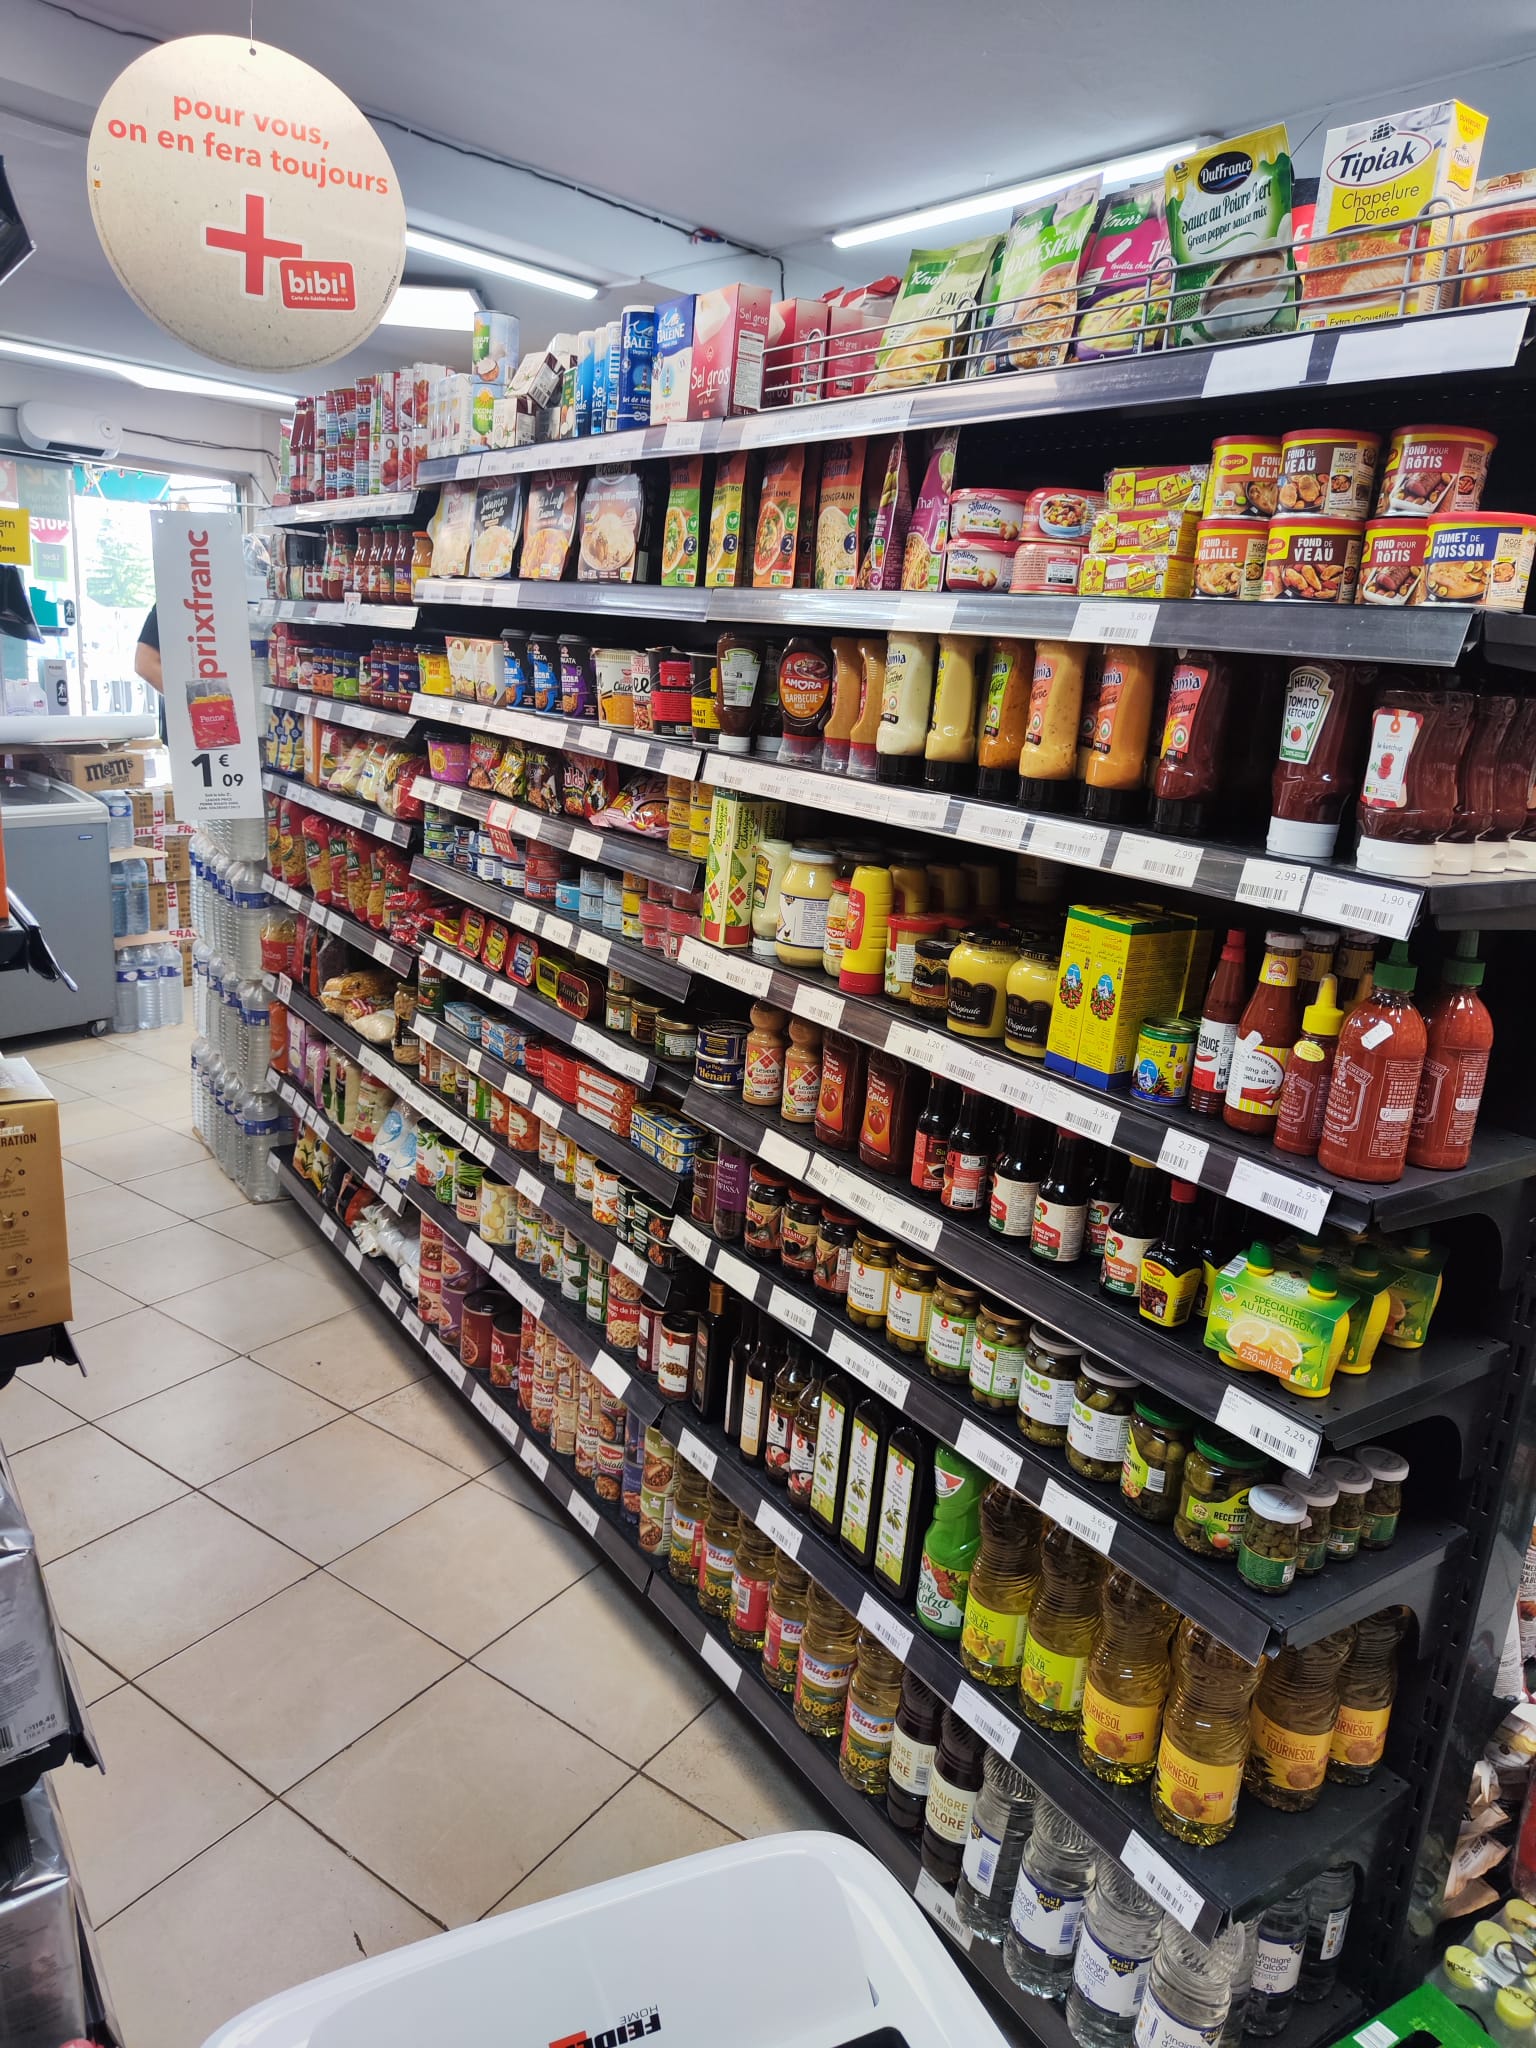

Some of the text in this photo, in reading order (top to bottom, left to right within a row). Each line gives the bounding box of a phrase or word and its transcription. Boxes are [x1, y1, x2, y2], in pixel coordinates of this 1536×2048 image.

[174, 95, 330, 150] pour vous,
[108, 119, 388, 195] on en fera toujours
[1339, 141, 1418, 182] Tipiak
[1342, 184, 1420, 211] Chapelure
[1209, 207, 1221, 223] au
[1223, 194, 1250, 219] Poivre
[1355, 204, 1400, 223] Dorée
[1187, 206, 1267, 251] Green pepper sauce mix
[739, 308, 768, 327] Sel gros
[657, 323, 685, 344] BALEINE
[691, 366, 729, 397] Sel gros
[1287, 448, 1305, 459] FOND
[1404, 445, 1449, 456] FOND POUR
[1221, 457, 1243, 466] Maggi
[1285, 457, 1316, 474] VEAU
[1203, 538, 1229, 548] FOND DE
[1298, 538, 1333, 548] FOND DE
[1375, 540, 1395, 549] FOND
[1437, 532, 1480, 544] FUMET DE
[1294, 548, 1334, 562] VEAU
[1433, 544, 1485, 559] POISSON
[784, 677, 822, 690] AMORA
[1294, 675, 1320, 691] HEINZ
[785, 693, 818, 703] BARBECUE
[1288, 695, 1320, 710] TOMATO
[1287, 708, 1316, 720] KETCHUP
[1383, 744, 1403, 752] ketchup
[219, 754, 229, 767] €
[192, 753, 212, 787] 1
[222, 774, 243, 787] 09
[495, 841, 512, 854] PRIX
[1174, 849, 1193, 860] 2,99
[1275, 870, 1305, 884] 2,99 €
[1381, 893, 1414, 909] 1,90 €
[1178, 1140, 1197, 1154] 2,75
[1296, 1187, 1319, 1202] 2,95
[1254, 1295, 1305, 1319] SPÉCIALITÉ
[1240, 1300, 1253, 1311] AU
[1256, 1304, 1271, 1316] JUS
[1279, 1314, 1315, 1333] CITRON
[1241, 1349, 1268, 1367] 250 ml
[1284, 1426, 1314, 1448] 2,29 €
[1213, 1511, 1245, 1523] RECETTE
[969, 1609, 989, 1631] COLZA
[1266, 1735, 1317, 1762] TOURNESOL
[1175, 1884, 1193, 1903] 3,95
[1257, 1951, 1292, 1965] Vinaigre
[1255, 1960, 1288, 1972] d'alcool
[620, 2004, 659, 2025] HOME
